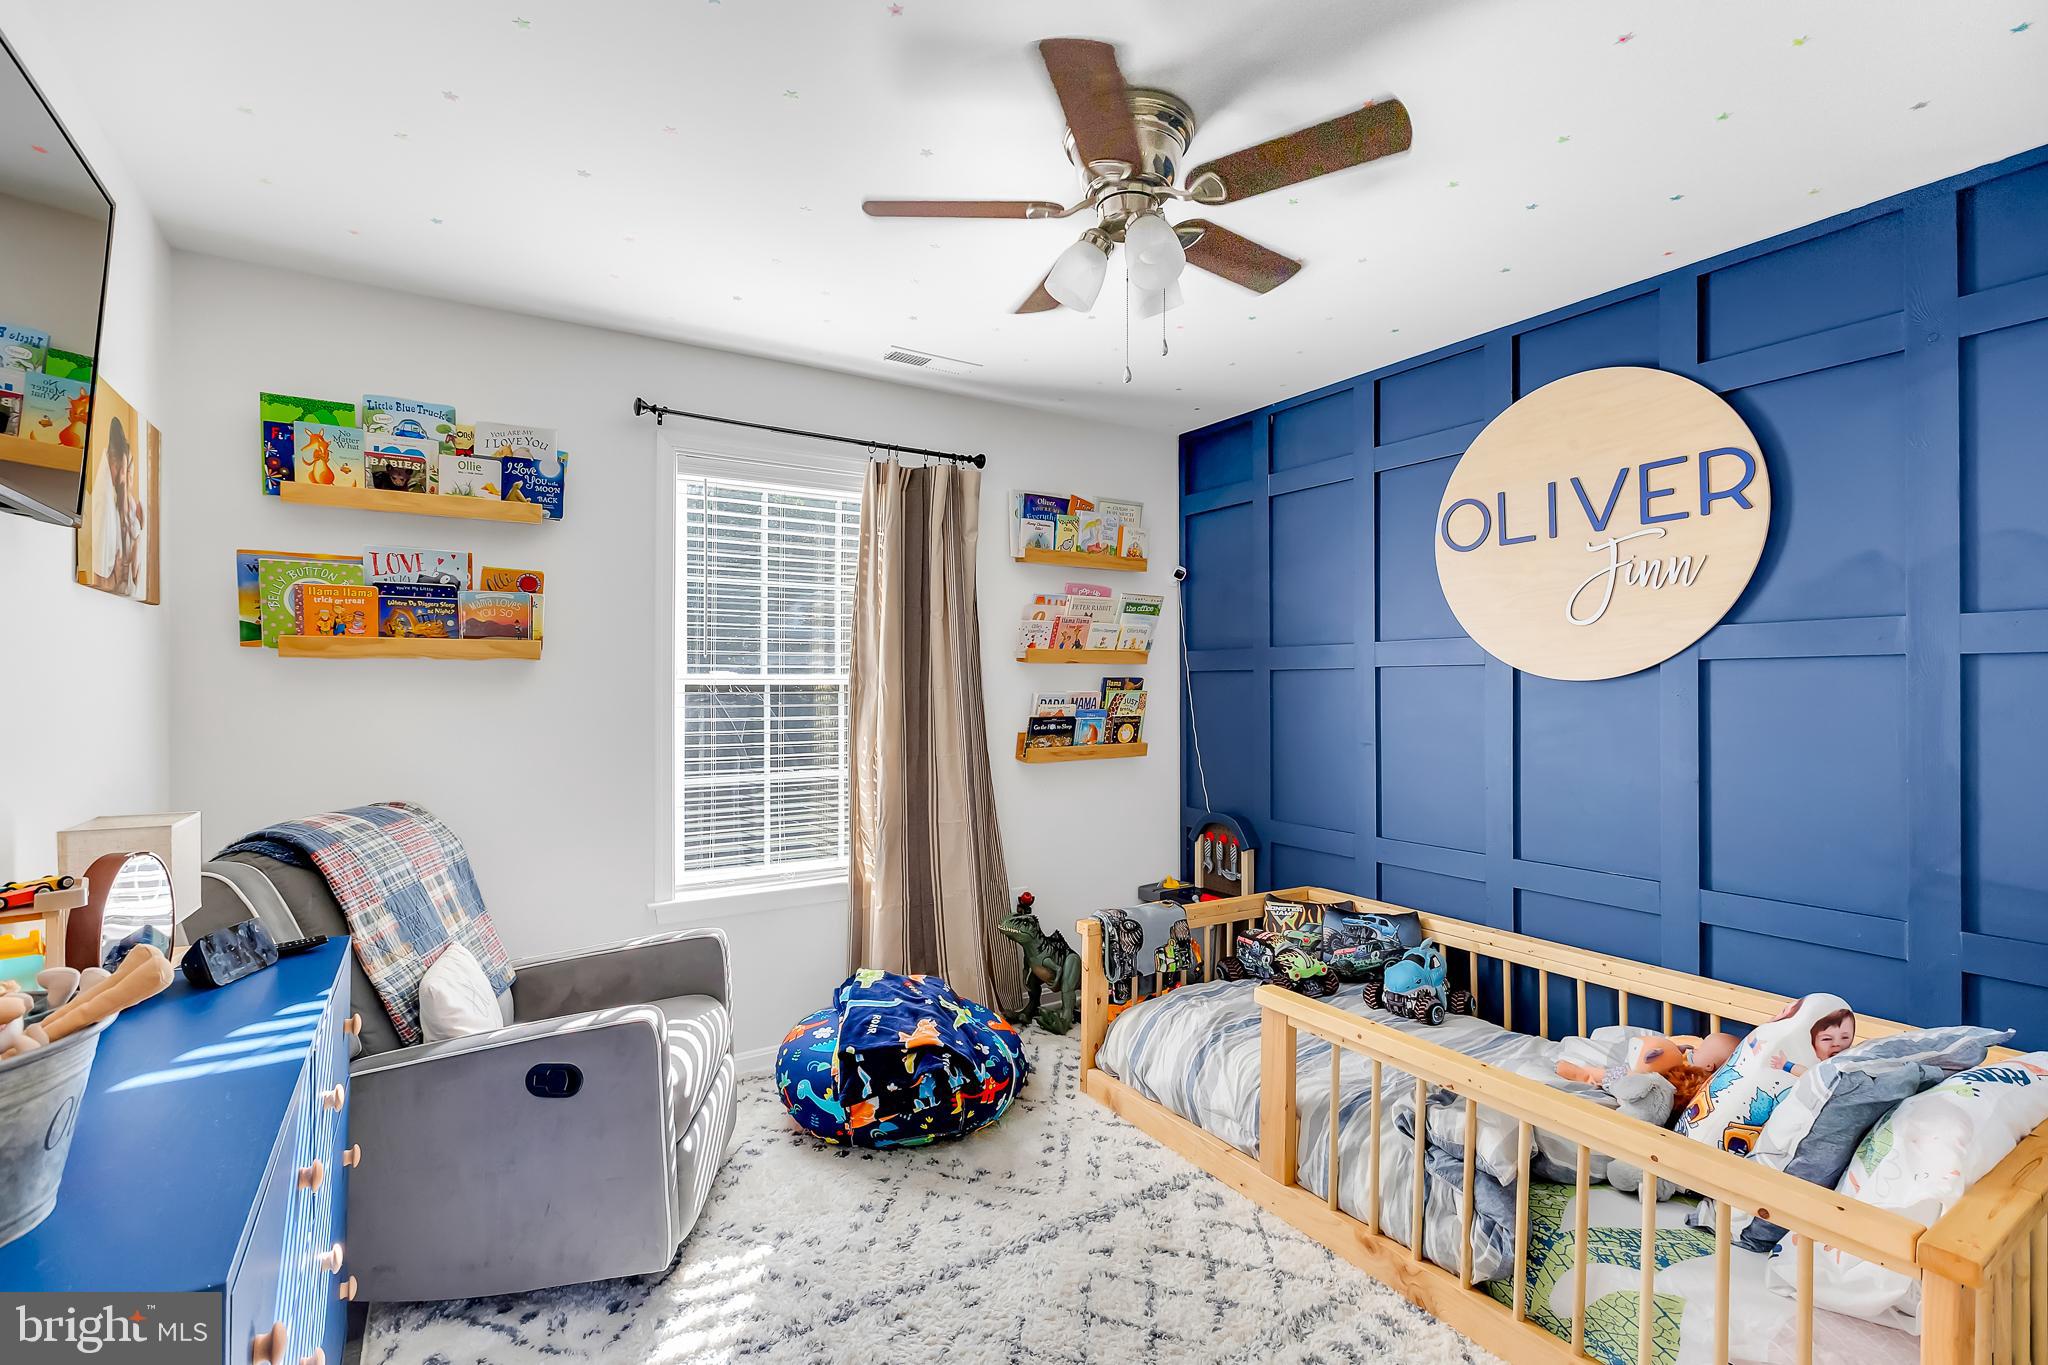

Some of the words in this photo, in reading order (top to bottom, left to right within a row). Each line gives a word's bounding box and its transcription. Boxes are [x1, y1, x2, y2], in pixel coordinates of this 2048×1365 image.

[366, 399, 393, 411] Little
[396, 401, 416, 413] Blue
[338, 429, 352, 438] No
[507, 429, 521, 437] ARE
[332, 434, 361, 445] Matter
[485, 438, 490, 449] I
[493, 437, 522, 449] LOVE
[336, 441, 360, 450] What
[370, 457, 425, 472] BABIES!
[457, 460, 482, 473] Ollie
[505, 462, 513, 474] I
[534, 485, 561, 494] MOON
[536, 495, 558, 504] BACK
[1440, 446, 1757, 553] OLIVER
[368, 551, 427, 577] LOVE
[1565, 526, 1708, 627] Finn
[267, 575, 288, 609] BELLY
[286, 566, 339, 582] BUTTON
[308, 586, 339, 597] llama
[343, 587, 373, 598] llama
[313, 595, 333, 604] trick
[344, 597, 365, 605] treat
[418, 600, 439, 608] Diggers
[434, 608, 456, 616] Night?
[477, 608, 496, 617] YOU
[499, 609, 514, 618] SO
[1126, 604, 1137, 612] the
[1071, 697, 1097, 709] MAMA
[1123, 698, 1139, 706] JUST
